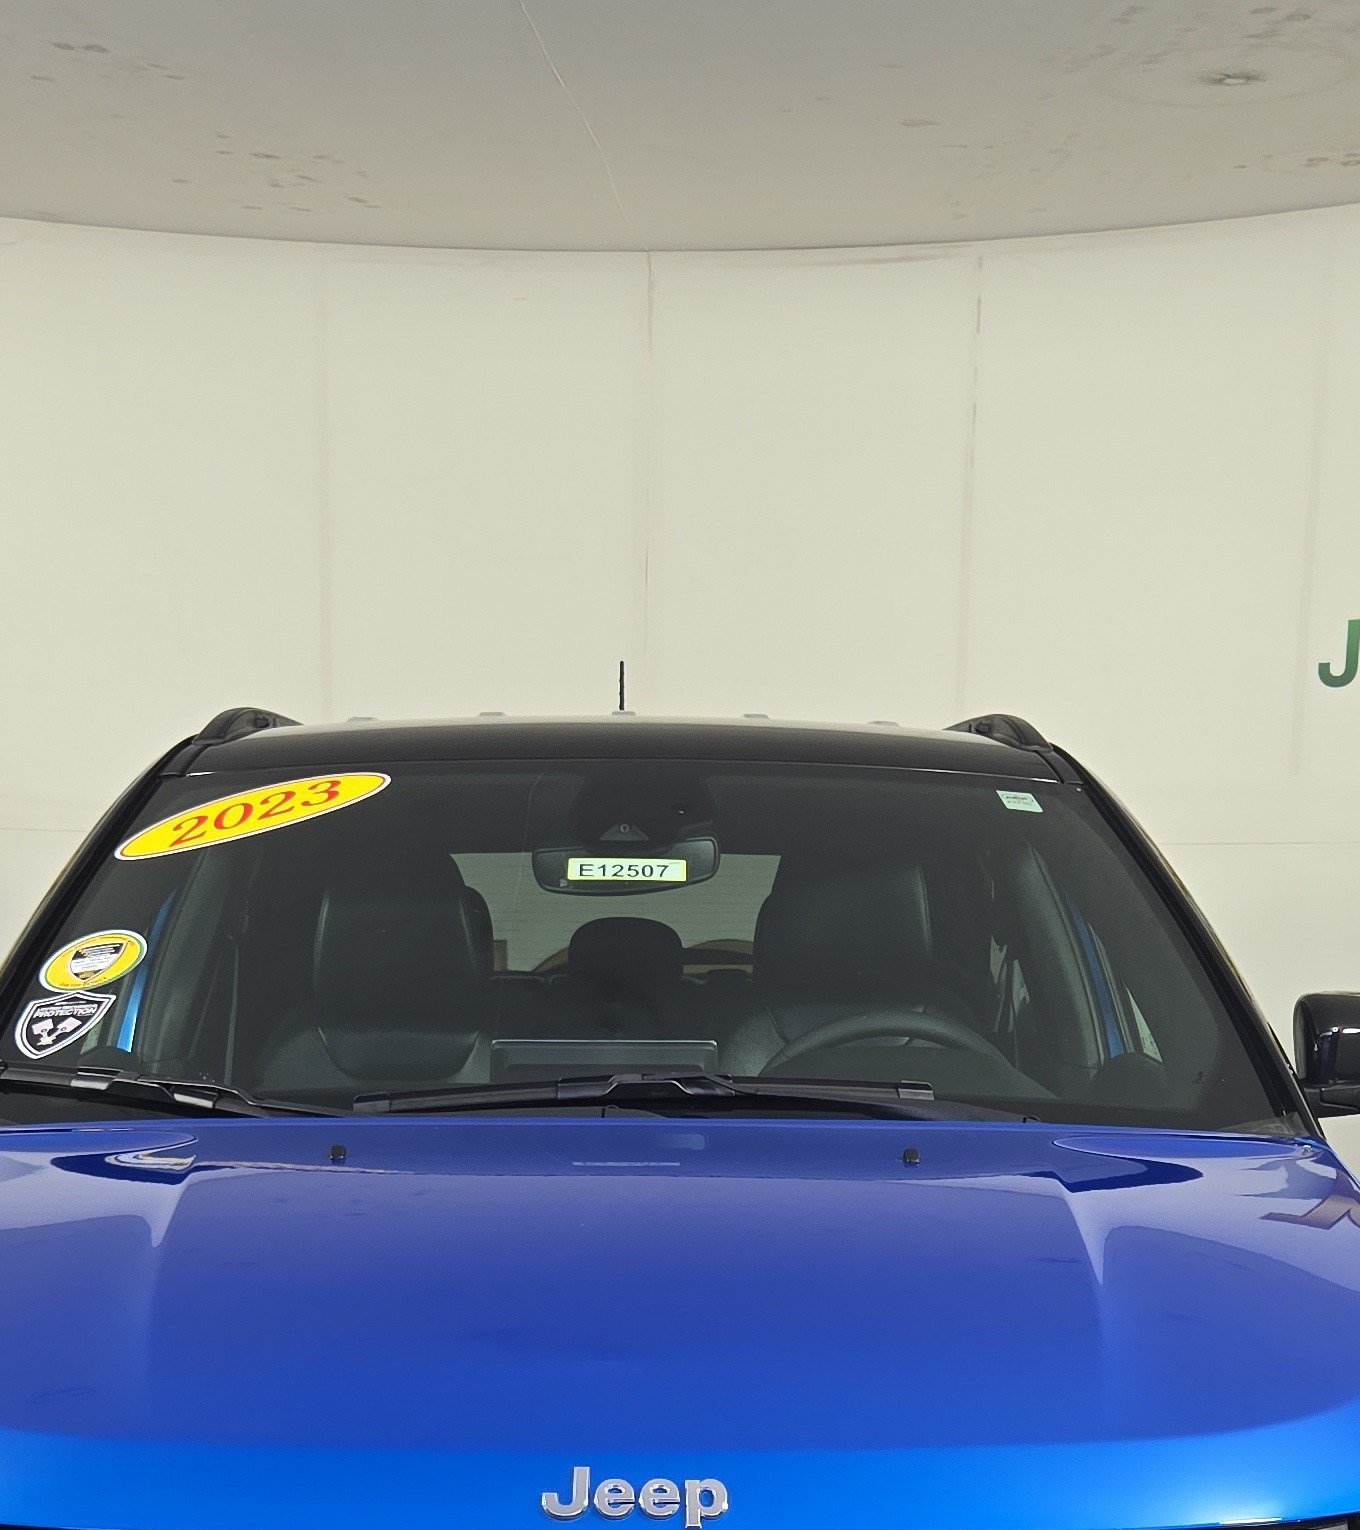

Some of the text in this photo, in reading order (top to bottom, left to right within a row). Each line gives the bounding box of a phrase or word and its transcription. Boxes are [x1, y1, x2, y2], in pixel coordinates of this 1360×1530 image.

[171, 779, 342, 847] 2023
[579, 864, 669, 878] E12507
[542, 1466, 729, 1530] Jeep
